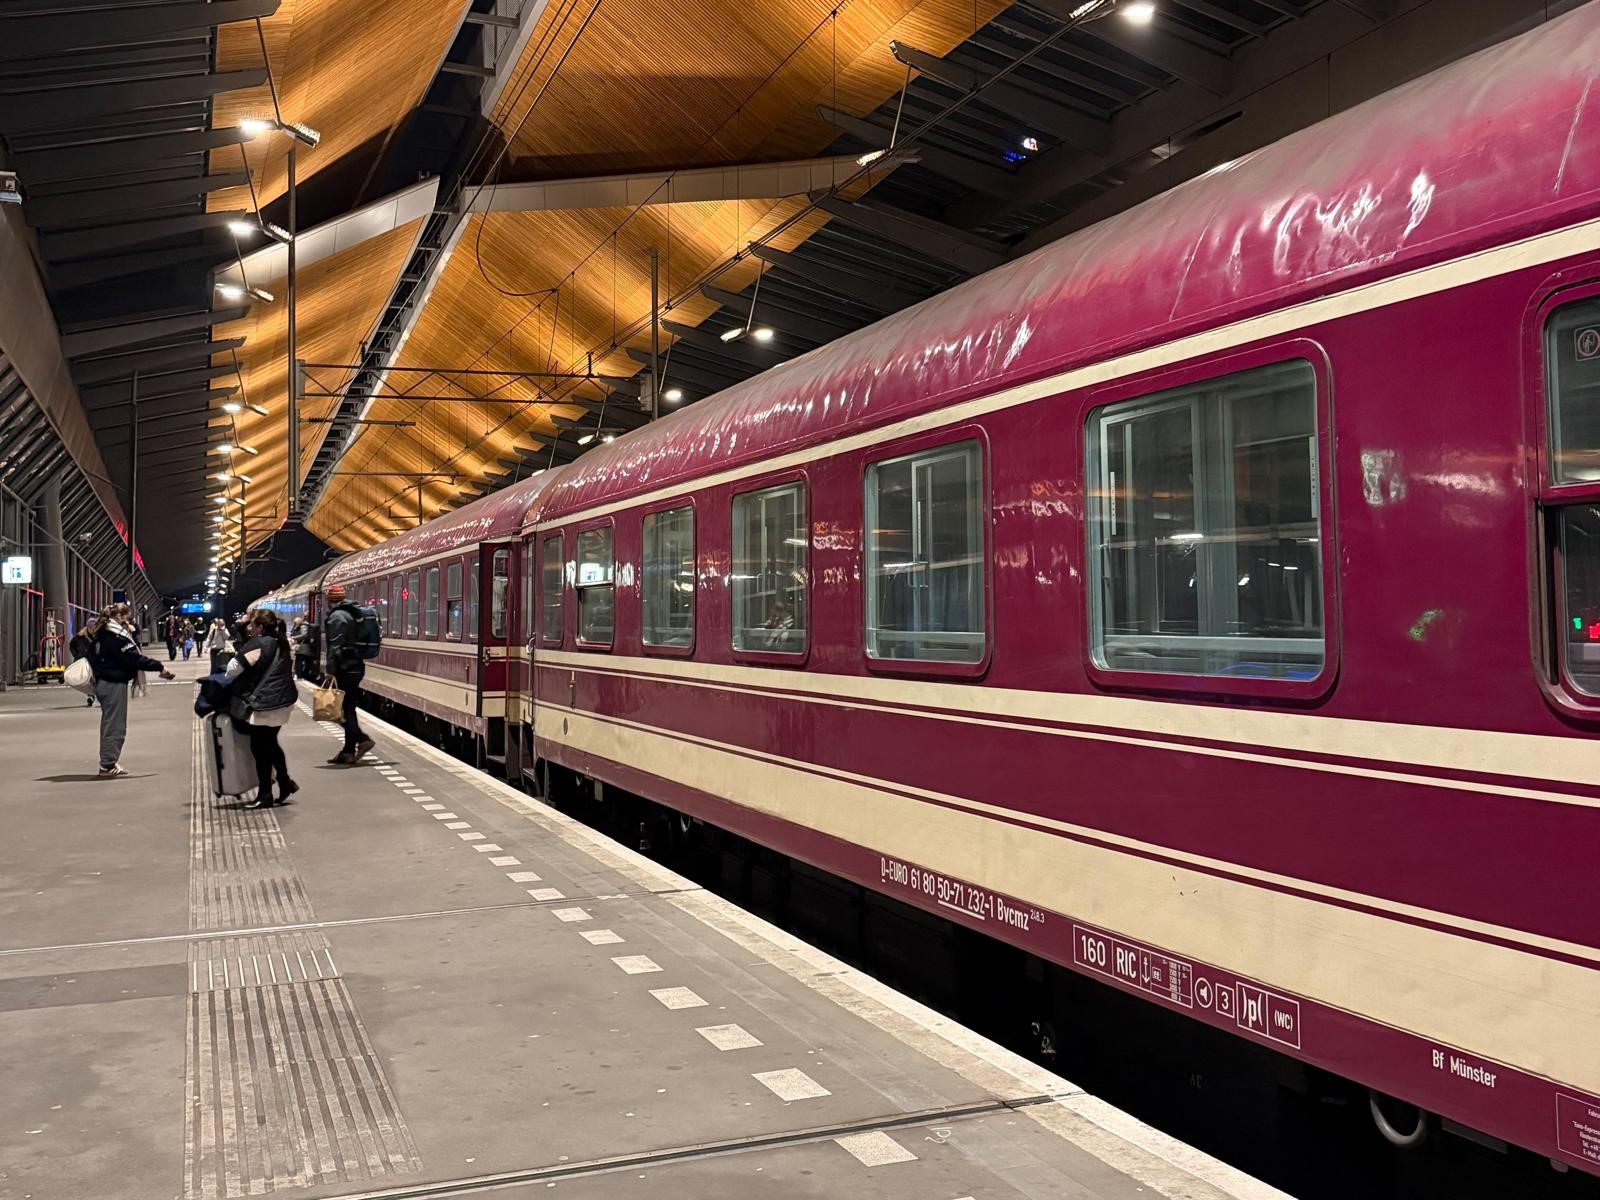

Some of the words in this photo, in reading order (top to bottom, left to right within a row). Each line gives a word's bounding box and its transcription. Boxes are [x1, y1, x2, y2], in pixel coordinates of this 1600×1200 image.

[881, 857, 908, 885] D-EURO
[911, 868, 921, 890] 61
[923, 873, 935, 895] 80
[937, 877, 964, 906] 50-71
[967, 888, 994, 918] 232-1
[998, 898, 1029, 931] Bvcmz
[1081, 935, 1106, 967] 160
[1116, 947, 1136, 978] RIC
[1221, 991, 1229, 1010] 3
[1274, 1010, 1293, 1031] (WC)
[1432, 1049, 1444, 1070] Bf
[1450, 1055, 1497, 1088] Münster
